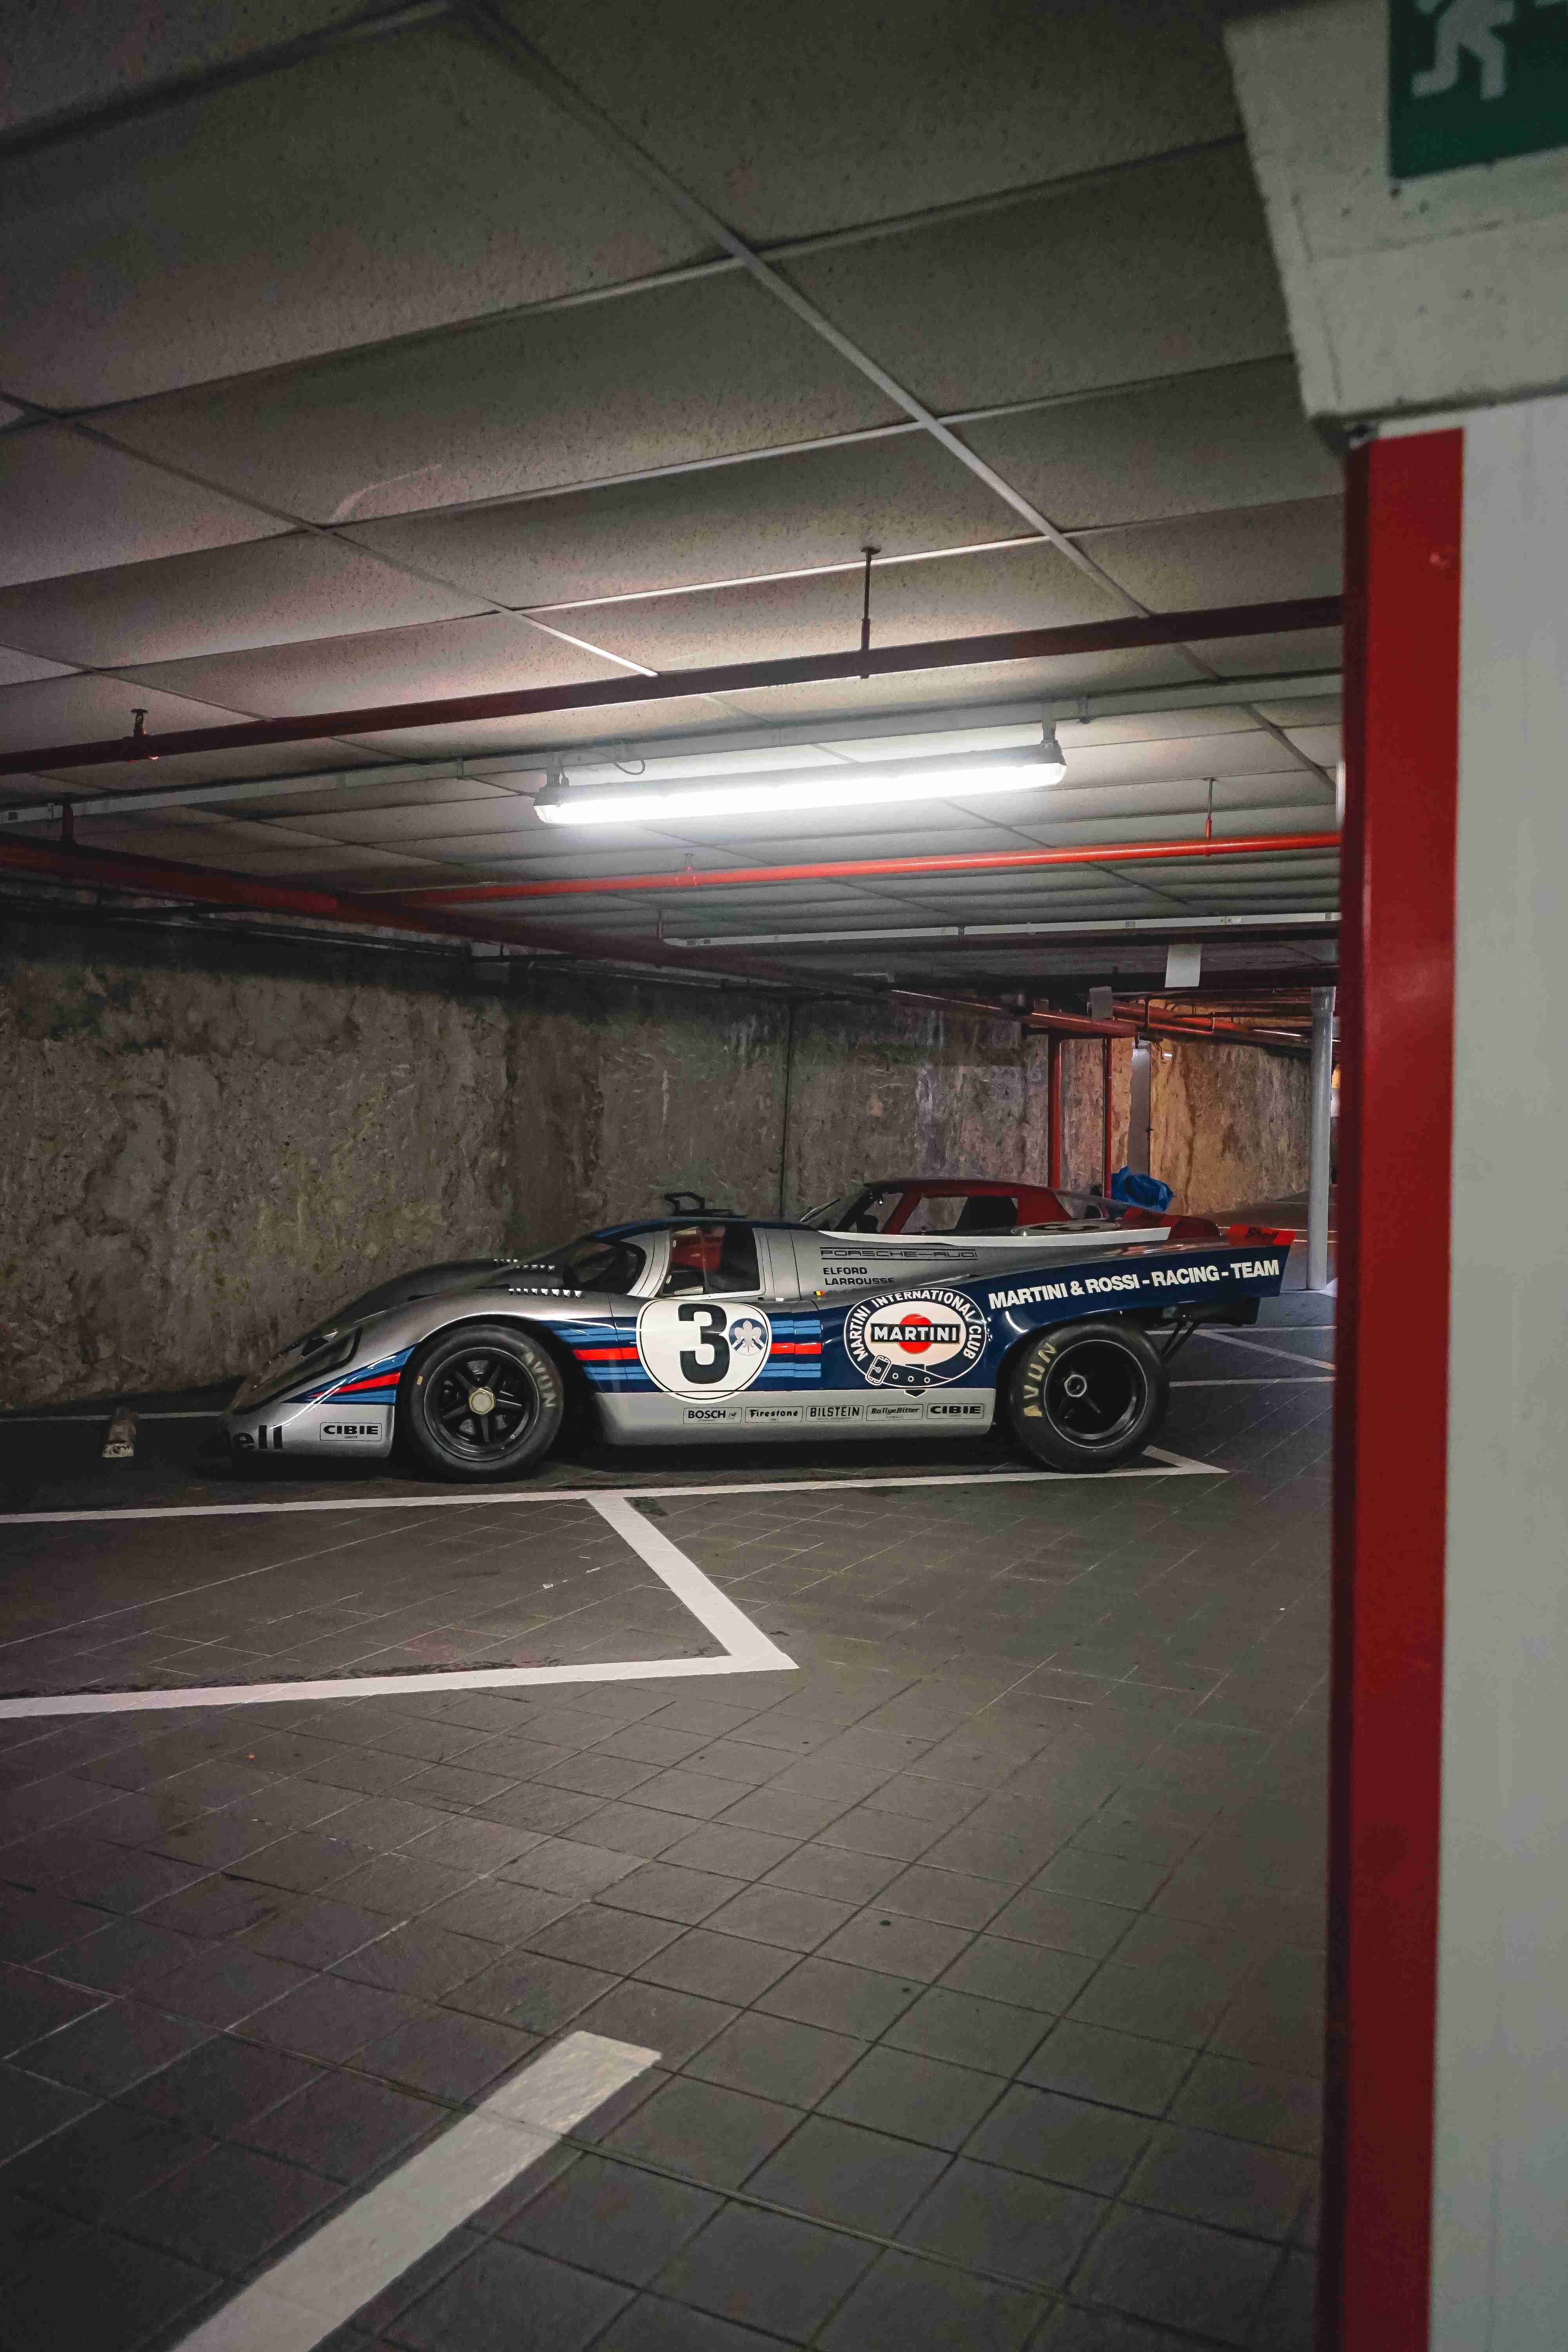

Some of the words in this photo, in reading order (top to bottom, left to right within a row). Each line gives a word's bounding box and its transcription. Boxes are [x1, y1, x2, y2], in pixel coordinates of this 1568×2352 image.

[823, 1267, 868, 1275] ELFORD
[825, 1277, 894, 1286] LARROUSSE
[988, 1283, 1069, 1309] MARTINI
[1070, 1280, 1085, 1296] &
[1085, 1274, 1140, 1293] ROSSI
[1151, 1265, 1220, 1287] RACING
[1230, 1259, 1280, 1279] TEAM
[849, 1305, 872, 1362] MARTINI
[871, 1290, 976, 1321] INTERNATIONAL
[963, 1325, 982, 1359] CLUB
[874, 1326, 957, 1341] MARTINI
[677, 1303, 730, 1384] 3
[688, 1410, 726, 1419] BOSCH
[749, 1409, 799, 1418] Firestone
[810, 1406, 860, 1417] BILSTEIN
[930, 1406, 981, 1414] CIBIE
[323, 1425, 379, 1435] CIBIE
